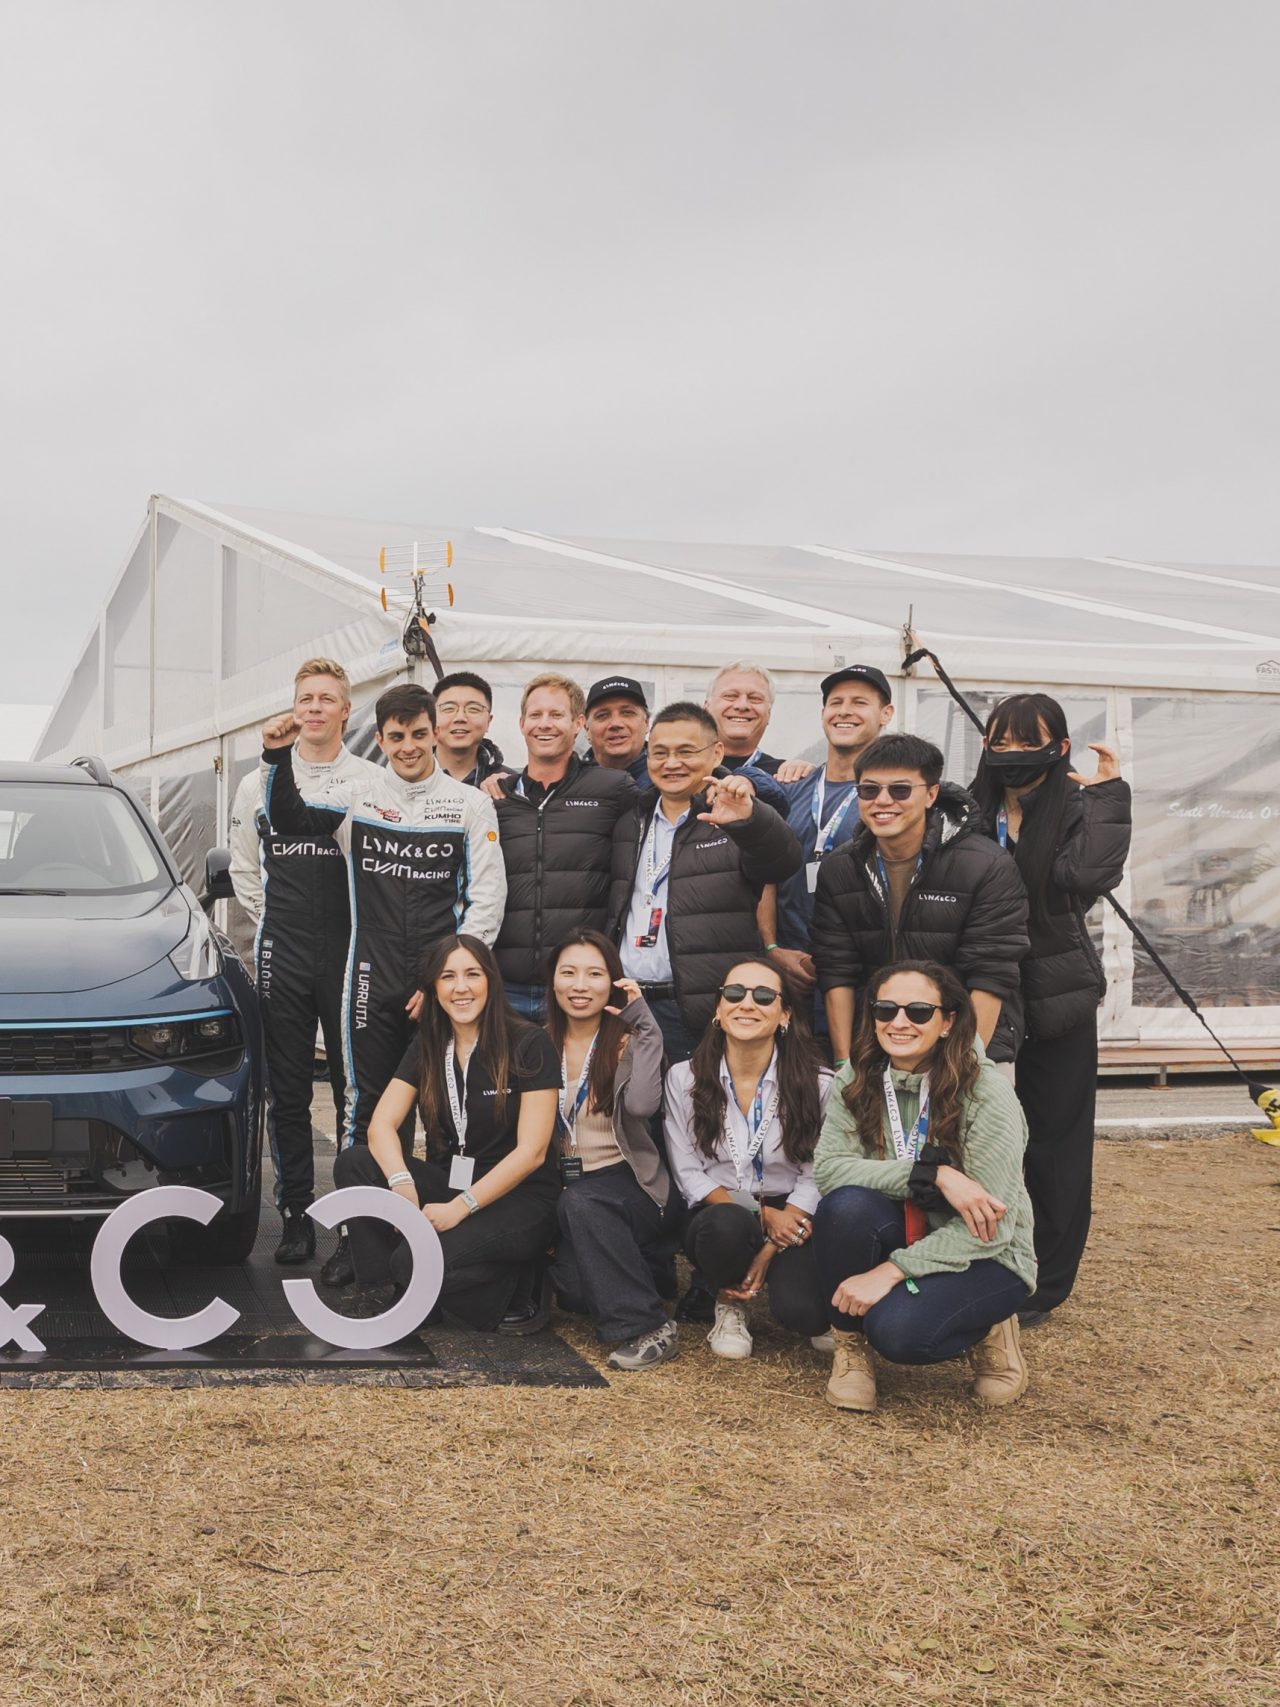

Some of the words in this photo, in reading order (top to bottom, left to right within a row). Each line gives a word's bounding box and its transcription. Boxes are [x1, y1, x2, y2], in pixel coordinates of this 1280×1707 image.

[424, 813, 462, 821] KUMHO
[412, 870, 451, 880] RACING
[355, 974, 370, 1030] URRUTIA
